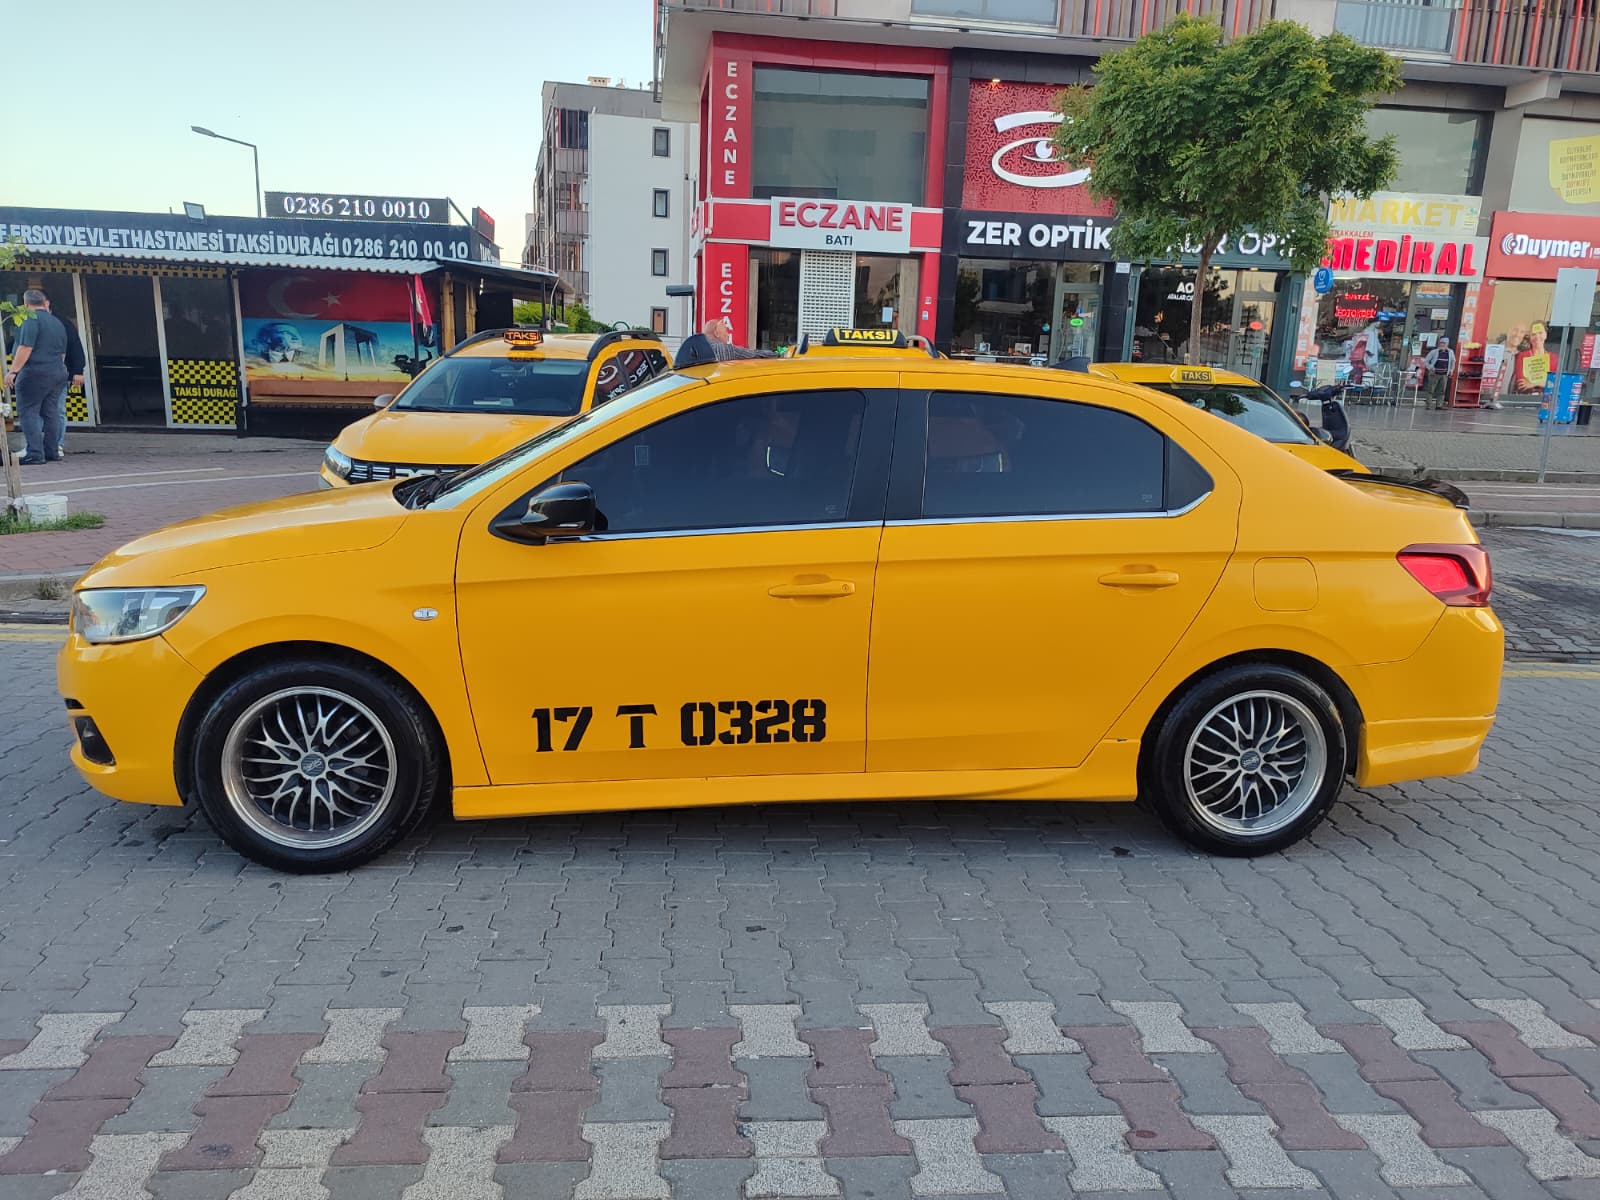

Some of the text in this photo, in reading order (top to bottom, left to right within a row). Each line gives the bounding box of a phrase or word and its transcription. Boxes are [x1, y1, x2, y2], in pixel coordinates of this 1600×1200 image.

[723, 62, 738, 185] ECZANE
[283, 197, 431, 219] 0286 210 0010
[778, 201, 904, 232] ECZANE
[1331, 198, 1465, 227] MARKET
[65, 226, 130, 248] DEVLET
[131, 229, 223, 251] HASTANESİ
[226, 231, 275, 254] TAKSİ
[277, 232, 340, 256] DURAĞI
[342, 238, 383, 258] 0286
[389, 240, 419, 259] 210
[449, 241, 469, 260] 10
[825, 234, 854, 247] BATI
[966, 219, 1114, 250] ZER OPTİK
[1512, 233, 1592, 259] Duymer
[1320, 234, 1477, 276] MEDİKAL
[174, 385, 238, 398] TAKSİ DURAĞI
[531, 699, 827, 752] 17 T 0328
